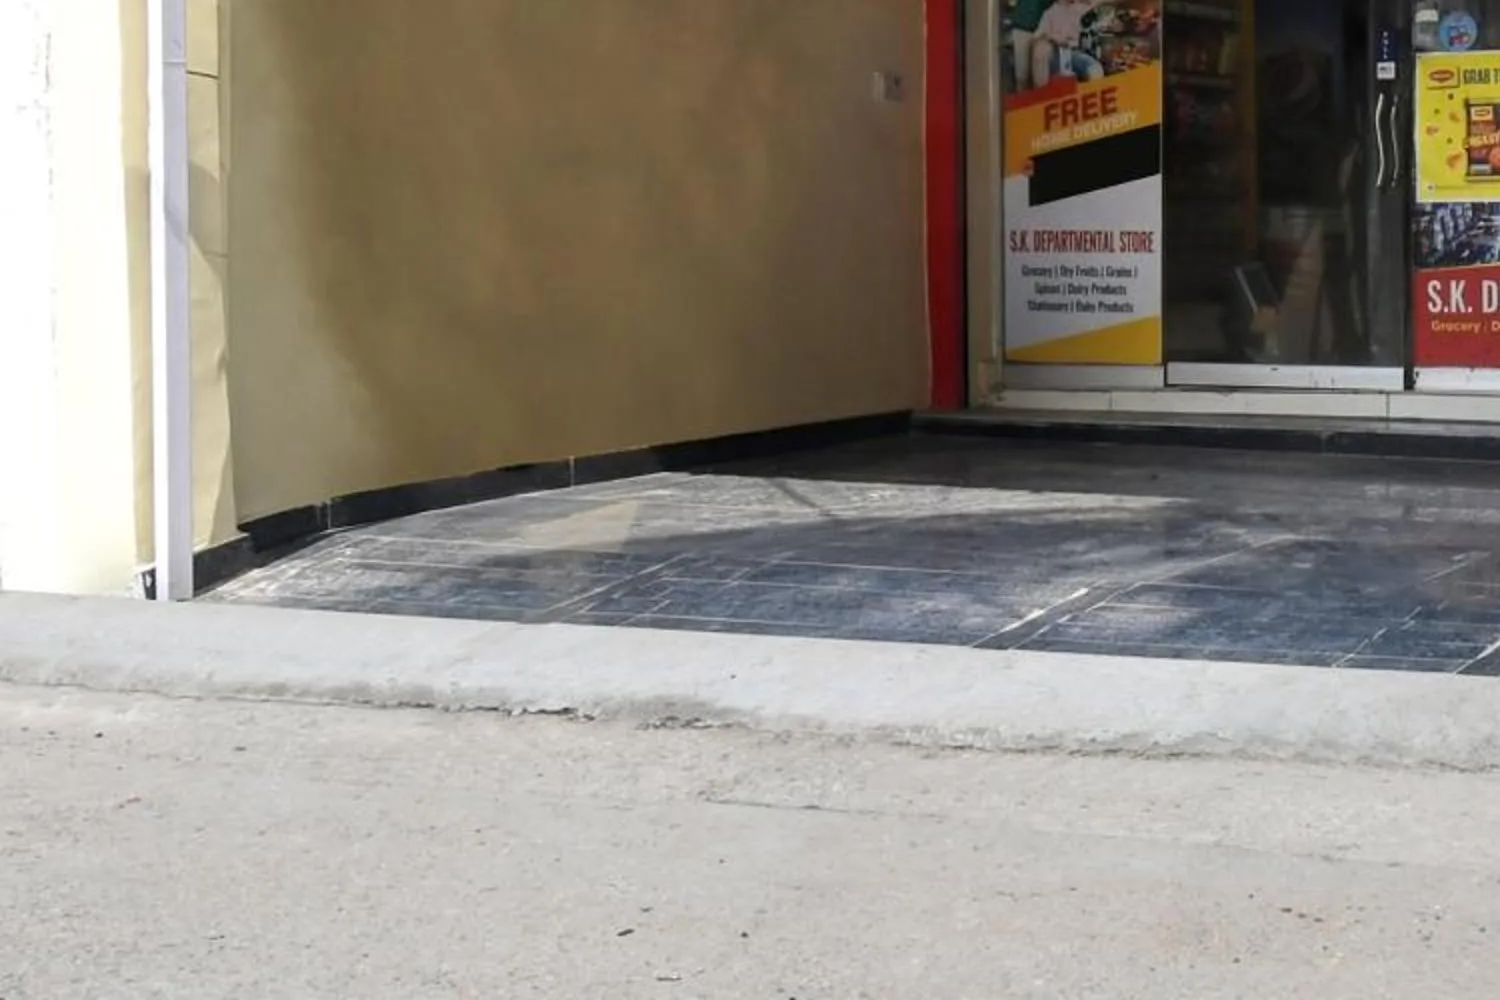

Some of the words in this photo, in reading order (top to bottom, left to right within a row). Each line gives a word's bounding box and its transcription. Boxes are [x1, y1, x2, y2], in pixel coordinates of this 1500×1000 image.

[1463, 68, 1490, 84] GRAB
[1043, 86, 1119, 132] FREE
[1073, 110, 1138, 138] DELIVERY
[1033, 229, 1115, 252] DEPARTMENTAL
[1119, 230, 1155, 253] STORE
[1427, 279, 1473, 314] S.K.
[1431, 320, 1481, 334] Grocery
